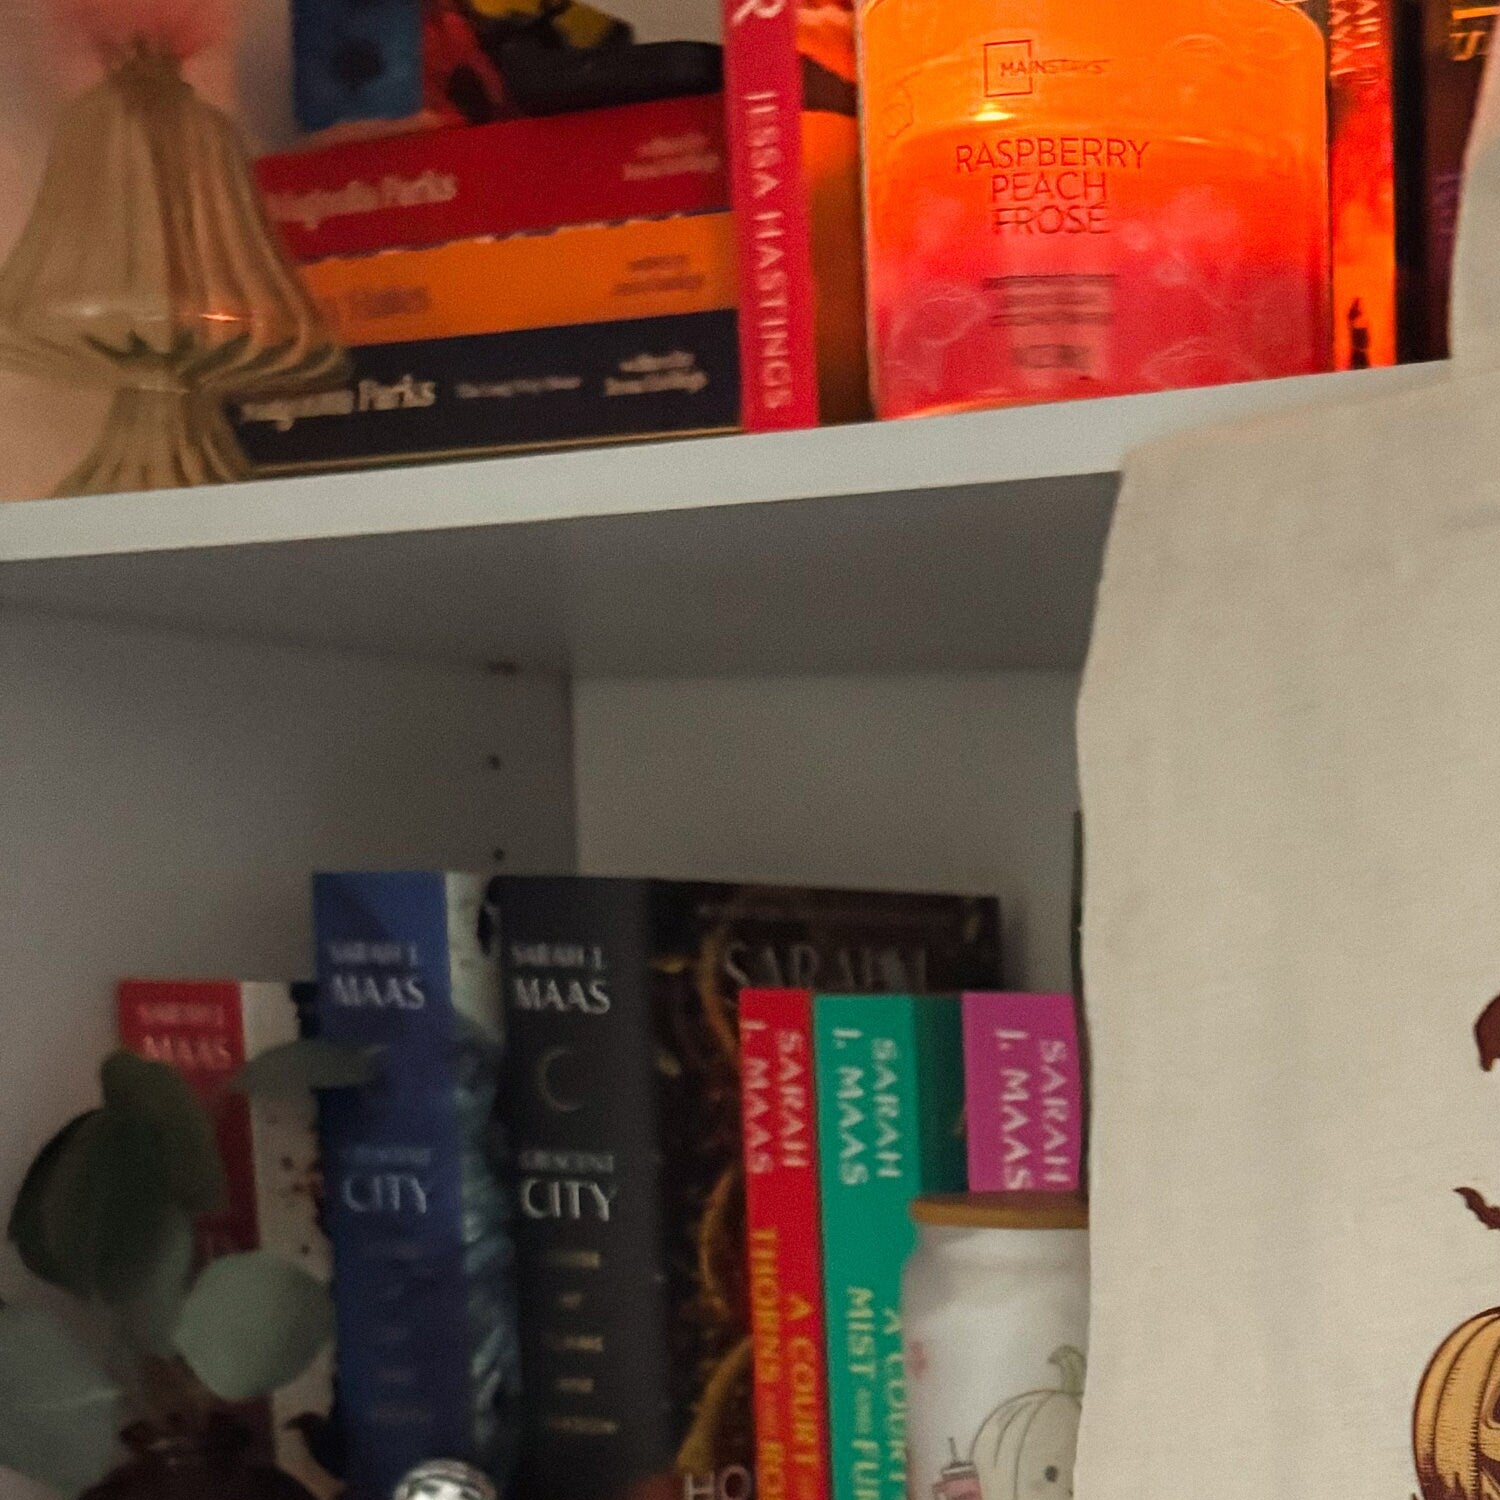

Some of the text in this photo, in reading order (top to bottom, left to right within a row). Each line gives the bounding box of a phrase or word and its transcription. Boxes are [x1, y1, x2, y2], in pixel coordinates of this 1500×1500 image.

[955, 136, 1150, 173] RASPBERRY
[991, 171, 1108, 203] PEACH
[513, 977, 611, 1014] MAAS
[744, 1056, 774, 1175] MAAS
[777, 1028, 809, 1168] SARAH
[838, 1065, 869, 1187] MAAS
[872, 1037, 903, 1179] SARAH
[1000, 1067, 1033, 1191] MAAS
[1040, 1038, 1071, 1183] SARAH
[520, 1177, 614, 1222] CITY
[847, 1286, 876, 1383] MIST
